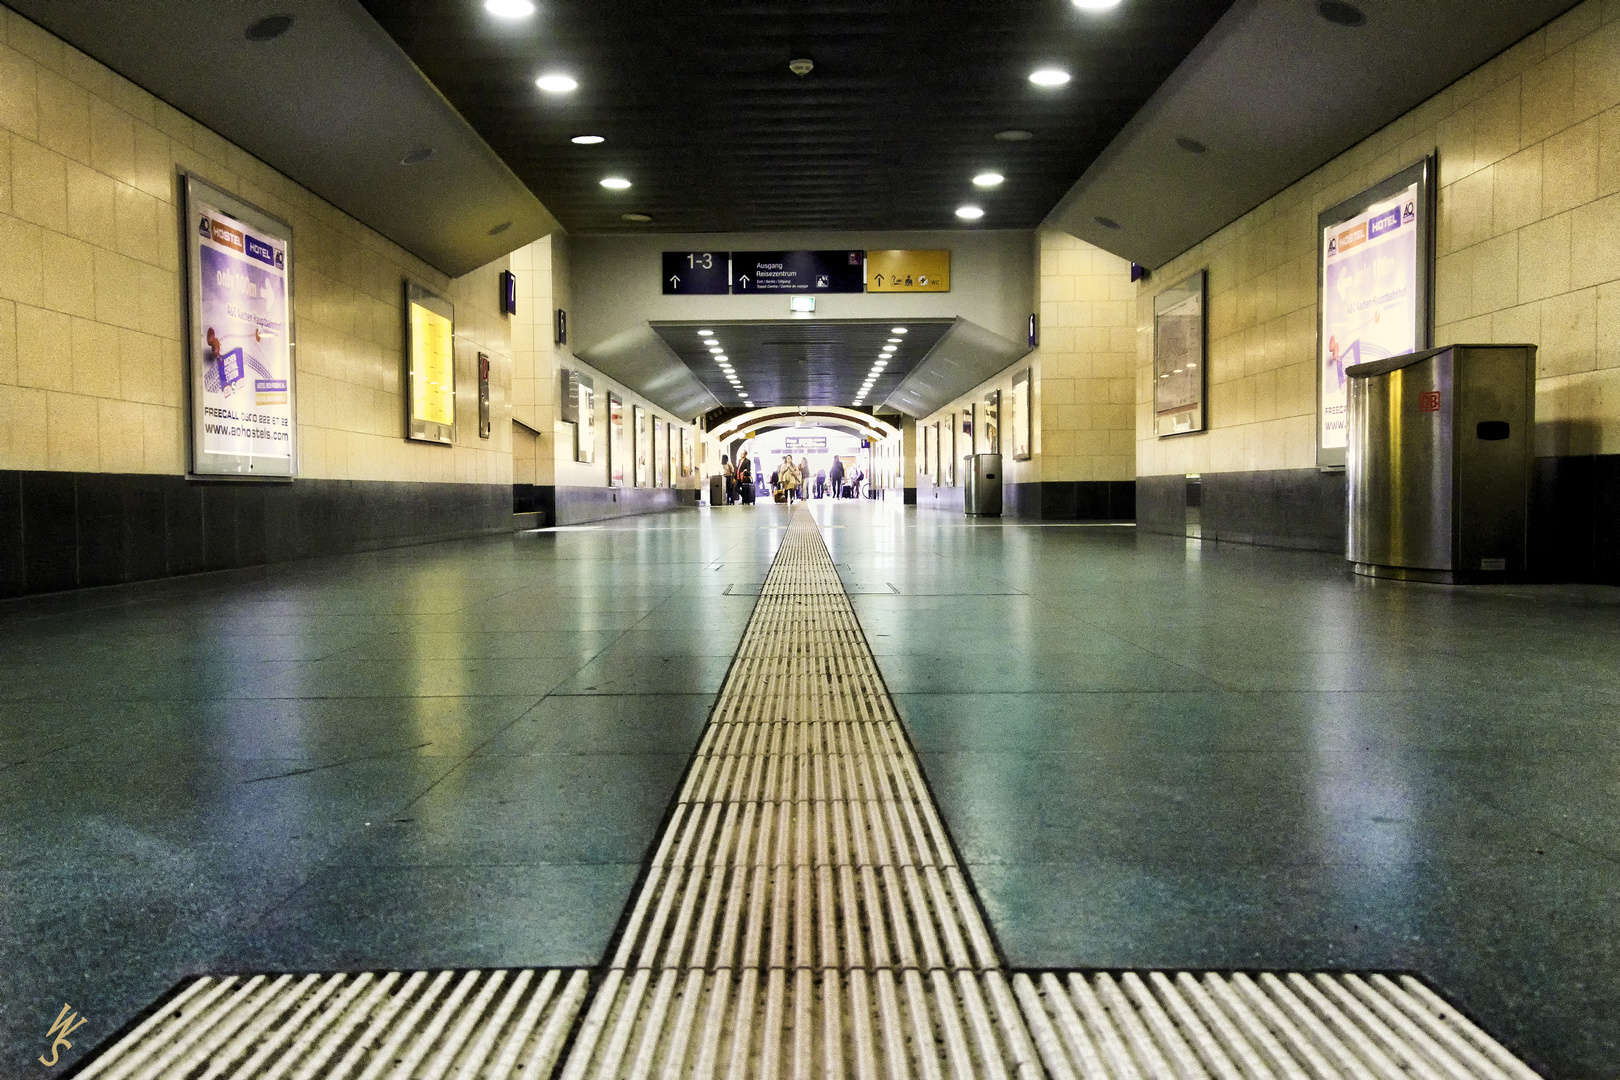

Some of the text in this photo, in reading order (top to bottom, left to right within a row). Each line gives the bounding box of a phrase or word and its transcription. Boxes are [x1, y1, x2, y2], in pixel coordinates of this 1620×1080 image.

[1340, 215, 1397, 247] HOSTEL HOTEL
[213, 226, 242, 247] HOSTEL
[249, 242, 271, 259] HOTEL
[687, 253, 713, 269] 1-3
[756, 262, 783, 270] Ausgang
[217, 268, 257, 298] only 100m
[204, 406, 239, 420] FREECALL
[258, 414, 271, 425] 222
[272, 416, 280, 425] 67
[281, 417, 288, 427] 22
[205, 423, 289, 441] www.aohostels.com
